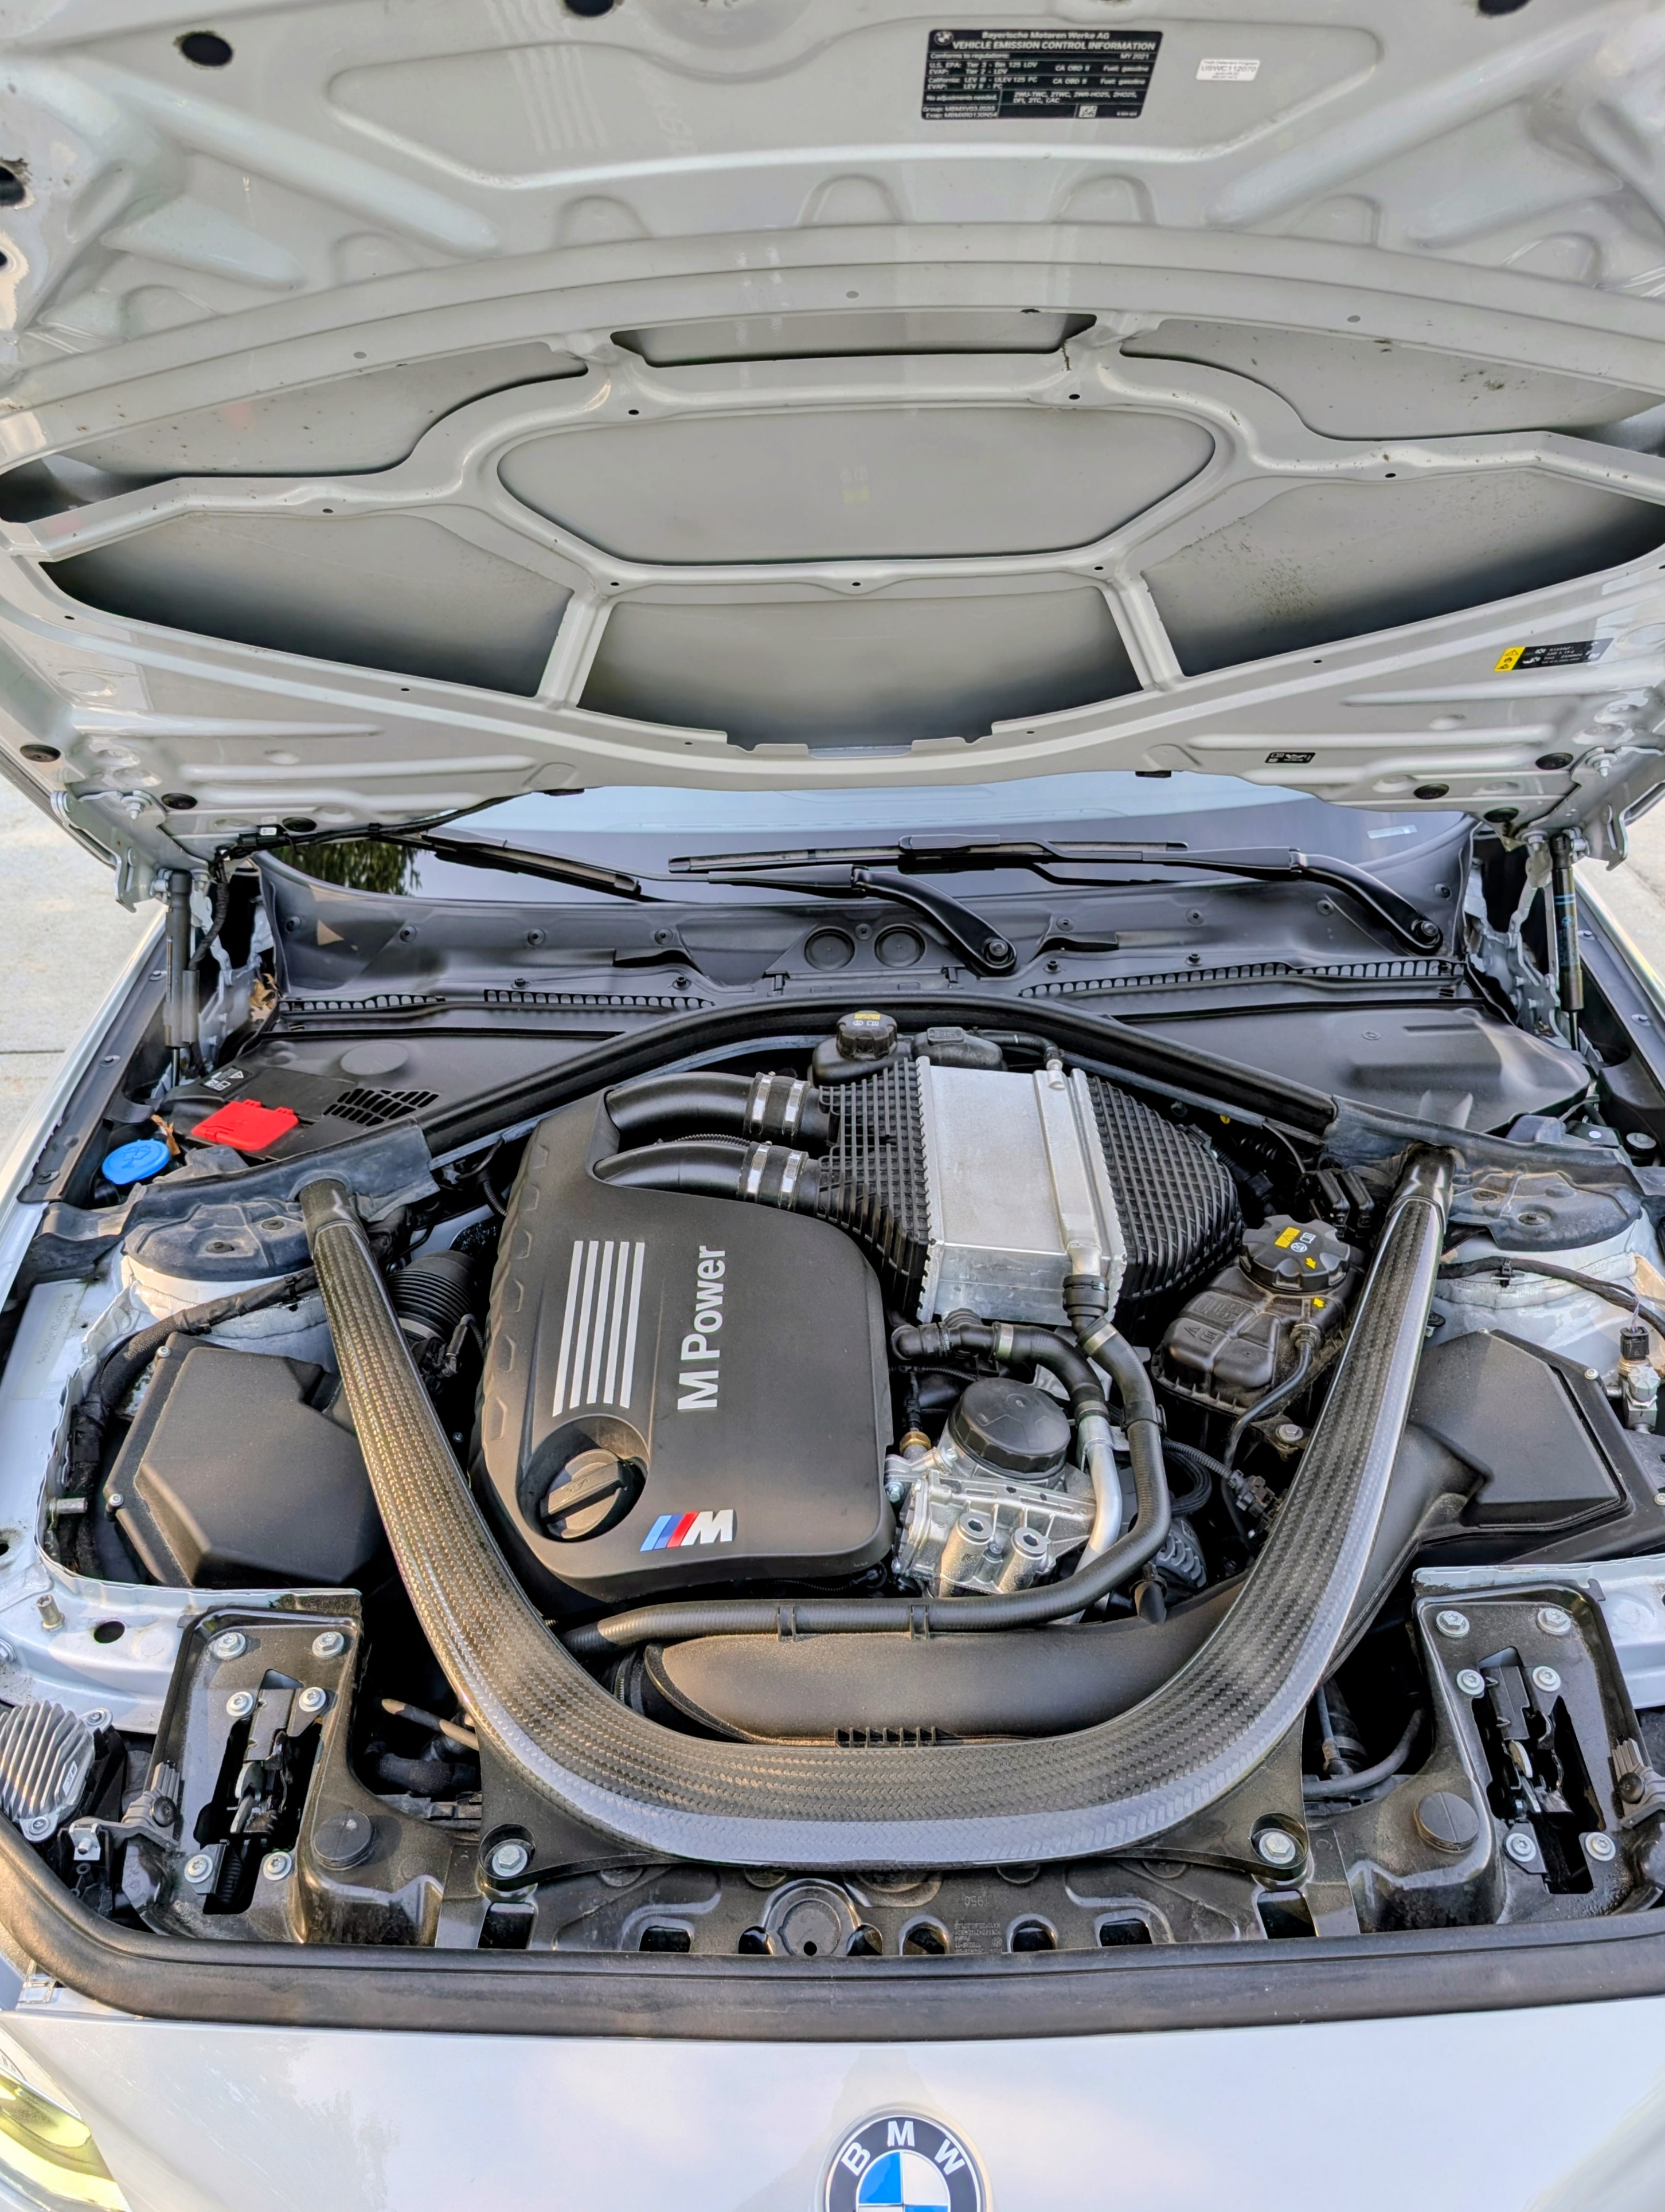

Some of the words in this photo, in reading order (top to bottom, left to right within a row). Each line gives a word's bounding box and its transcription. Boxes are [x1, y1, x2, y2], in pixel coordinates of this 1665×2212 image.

[952, 41, 992, 49] VEHICLE
[993, 41, 1040, 49] EMISSION
[1088, 42, 1155, 50] INFORMATION
[681, 1245, 726, 1361] Power
[677, 1370, 720, 1411] M
[841, 2120, 966, 2176] BMW
